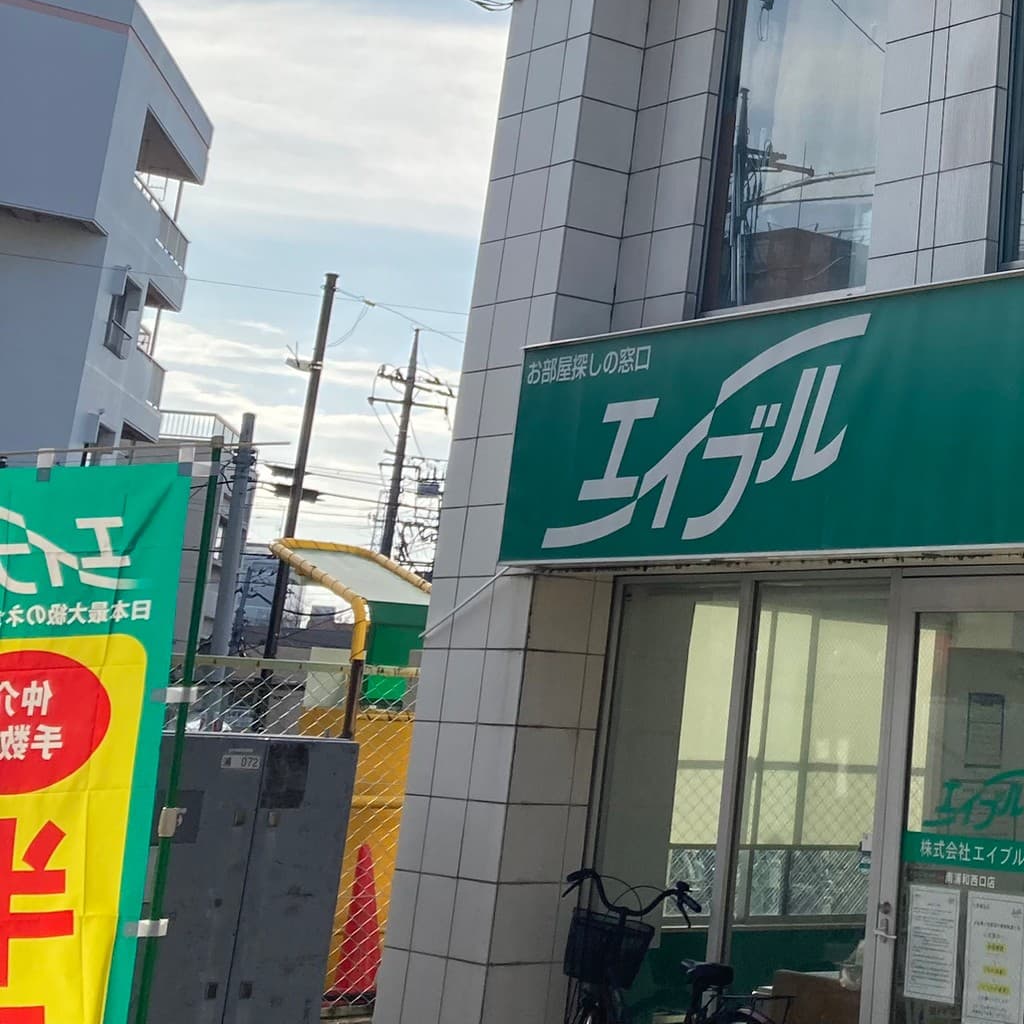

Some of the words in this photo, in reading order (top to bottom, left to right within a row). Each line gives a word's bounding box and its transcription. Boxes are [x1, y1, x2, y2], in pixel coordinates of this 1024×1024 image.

[527, 345, 651, 384] お部屋探しの窓口
[542, 313, 872, 549] エイブル
